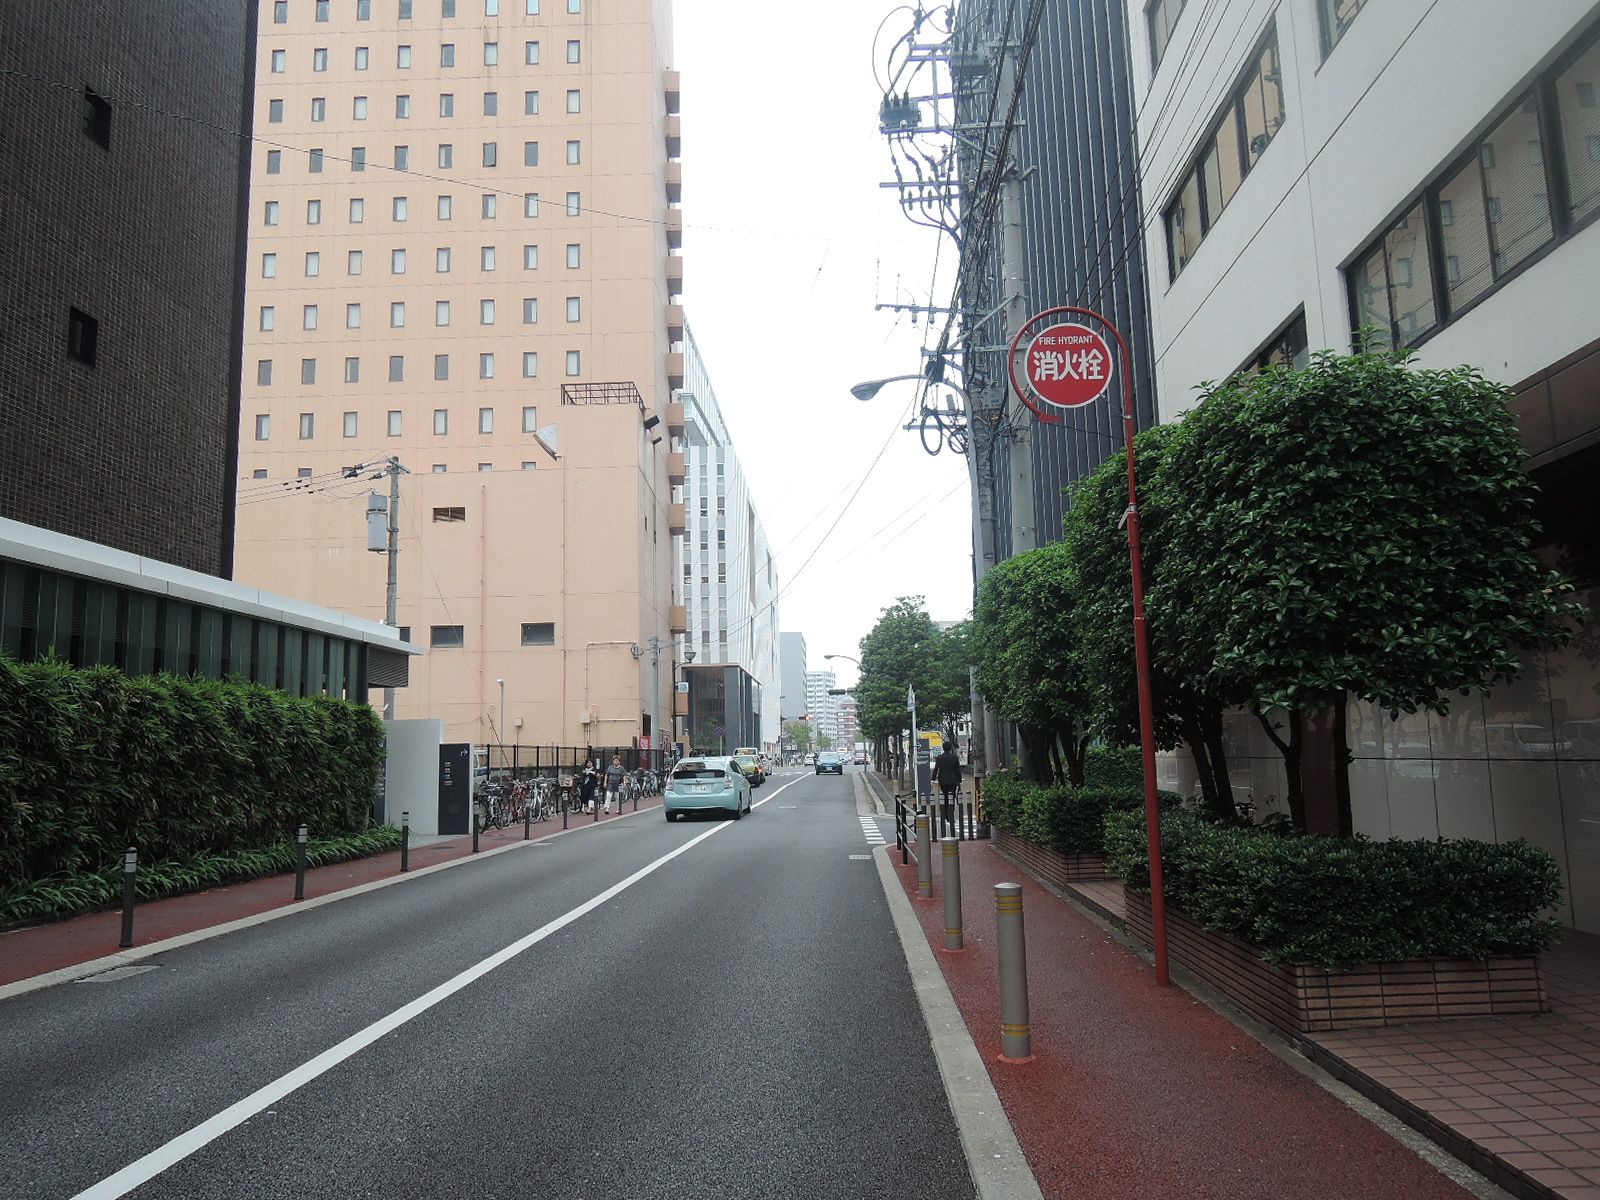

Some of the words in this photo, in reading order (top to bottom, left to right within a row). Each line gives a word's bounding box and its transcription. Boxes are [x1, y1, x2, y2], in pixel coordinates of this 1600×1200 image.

[1039, 336, 1056, 345] FIRE
[1058, 335, 1093, 345] HYDRANT
[1033, 348, 1104, 382] 消火栓
